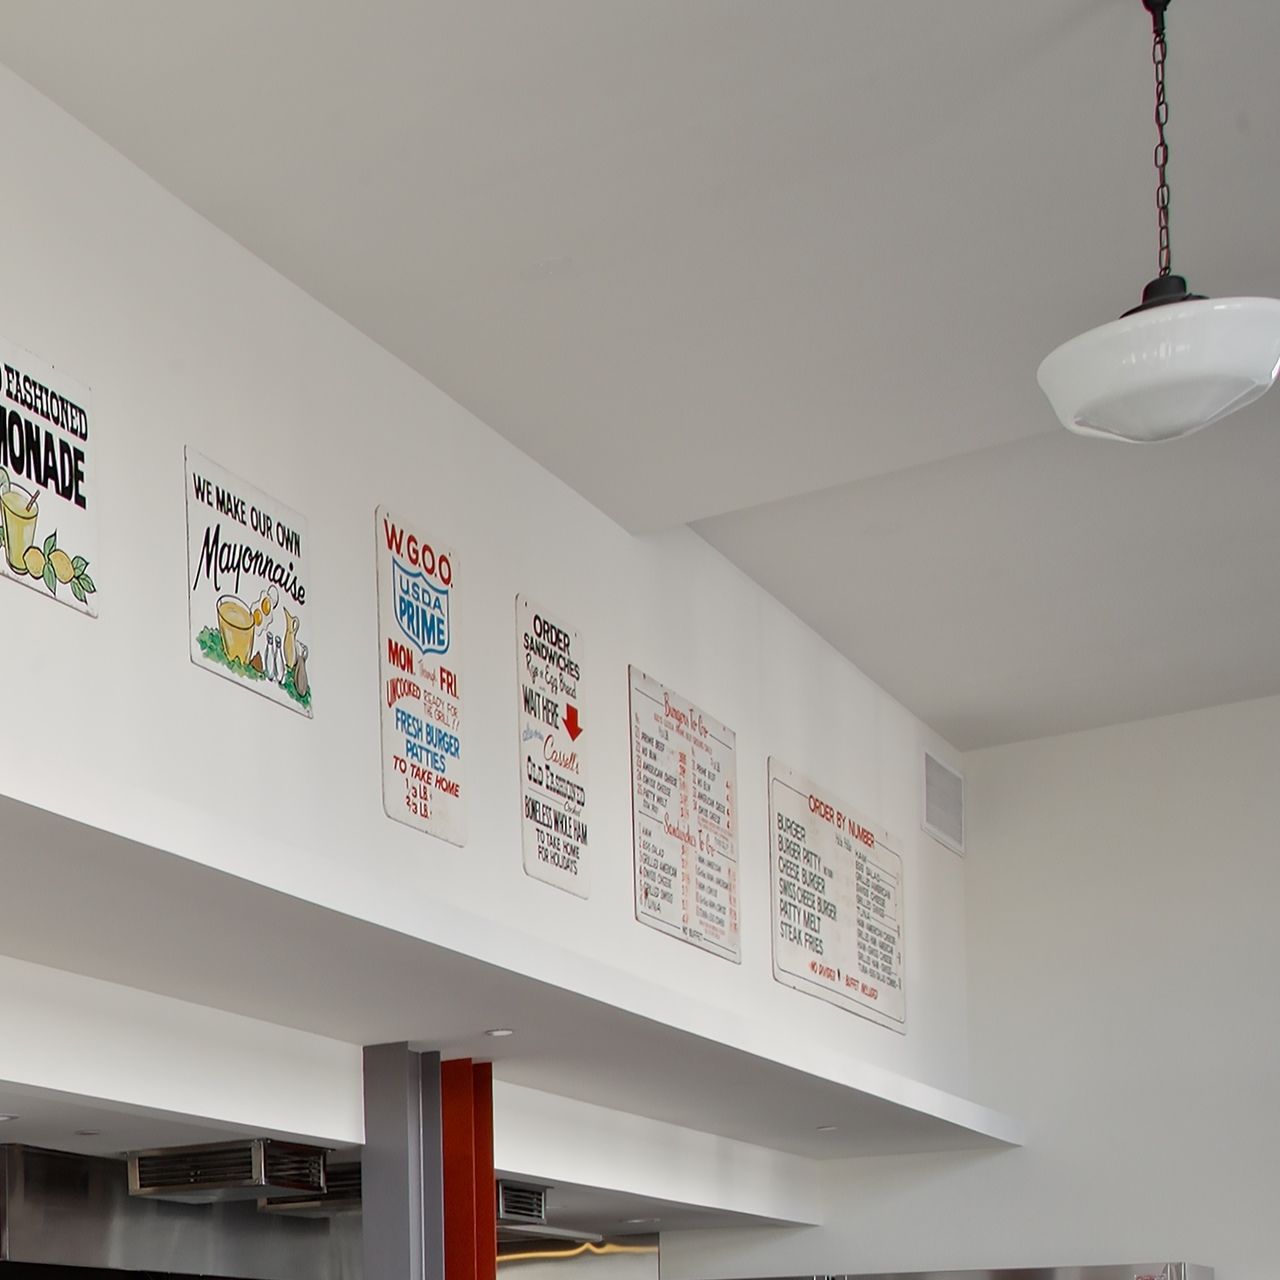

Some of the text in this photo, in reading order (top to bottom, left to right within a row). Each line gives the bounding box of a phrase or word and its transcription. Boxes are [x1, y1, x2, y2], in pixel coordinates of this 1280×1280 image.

[4, 364, 88, 441] FASHIONED
[193, 472, 300, 558] WE MAKE OUR OWN
[193, 523, 305, 606] Mayonnaise
[399, 594, 445, 655] PRIME
[533, 613, 570, 656] ORDER
[388, 637, 415, 676] MON.
[523, 631, 579, 682] SANDWICHES
[386, 670, 420, 721] UNCOOKED
[439, 666, 459, 699] FRI.
[395, 707, 459, 758] FRESH BURGER
[393, 754, 459, 799] TO TAKE HOME
[405, 738, 445, 774] PATTIES
[777, 811, 805, 843] BURGER
[808, 794, 834, 824] ORDER
[836, 811, 847, 831] BY
[848, 819, 875, 848] NUMBER
[778, 833, 801, 862] BURGER
[803, 846, 821, 873] PATTY
[801, 867, 825, 895] BURGER
[780, 919, 823, 956] STEAK FRIES
